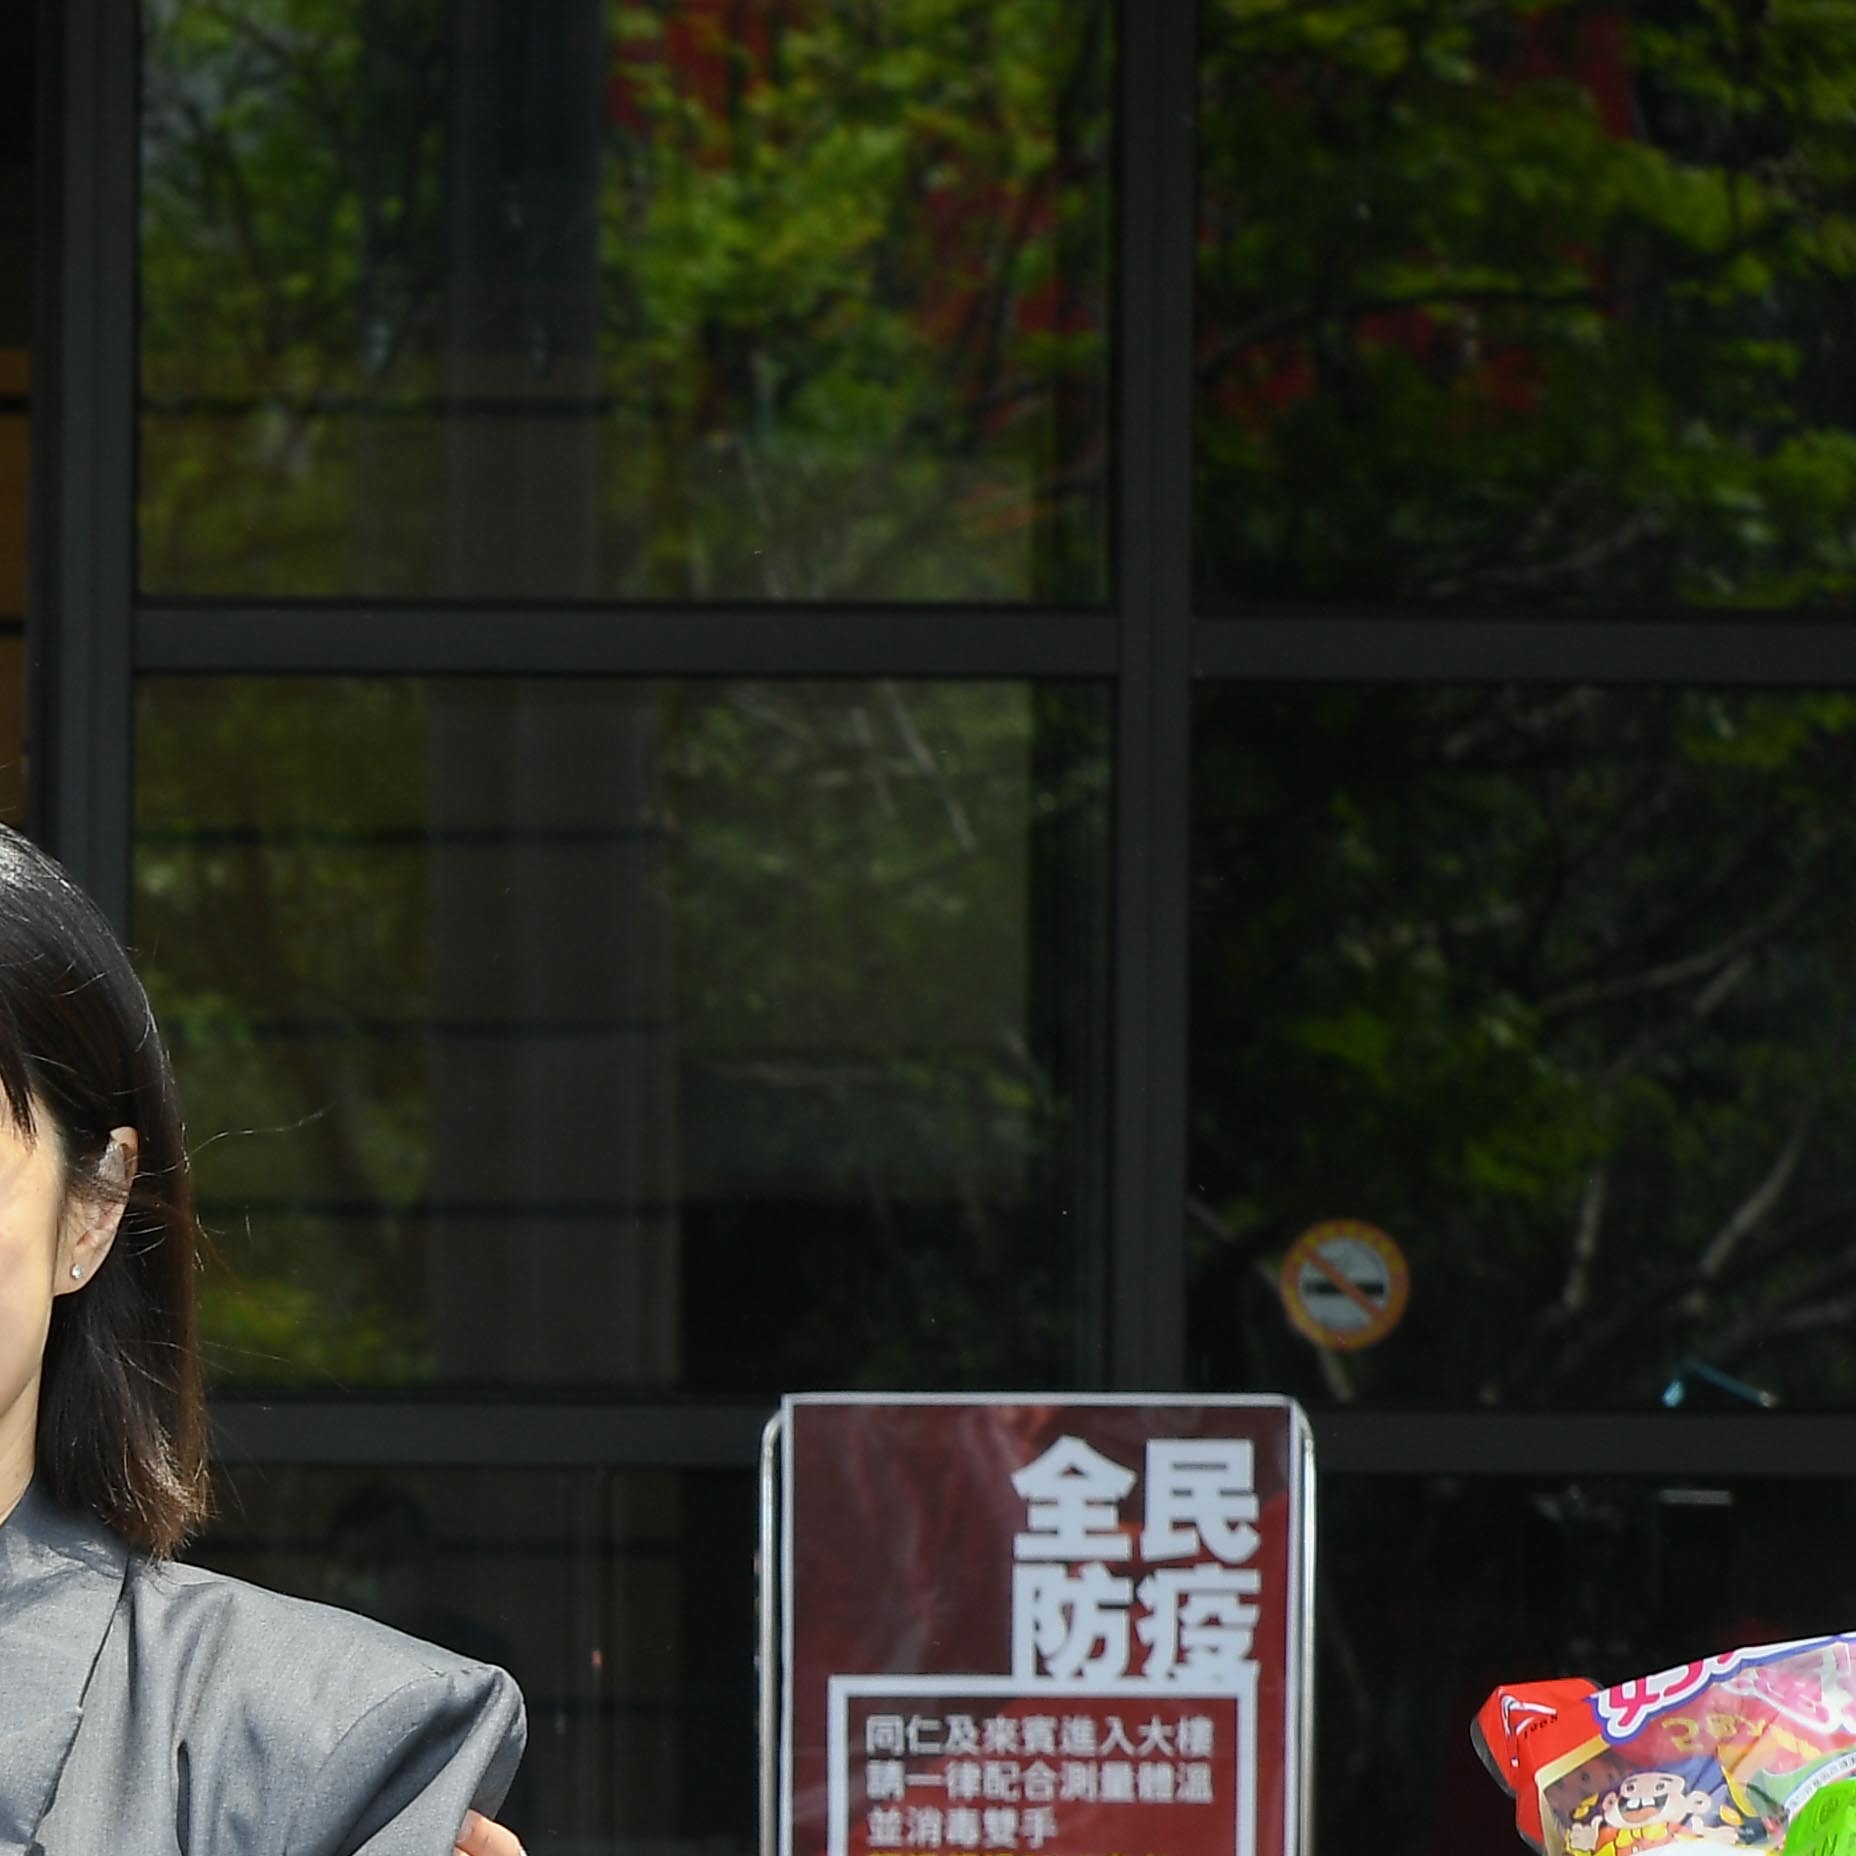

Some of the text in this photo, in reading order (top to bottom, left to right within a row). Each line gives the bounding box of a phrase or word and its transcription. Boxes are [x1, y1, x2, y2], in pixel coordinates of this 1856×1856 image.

[1012, 1436, 1260, 1562] 全民
[1012, 1565, 1261, 1686] 防疫
[866, 1714, 1214, 1757] 同仁及來賓進入大樓
[866, 1760, 1214, 1803] 請一律配合測量體溫
[866, 1806, 1059, 1848] 並消毒雙手
